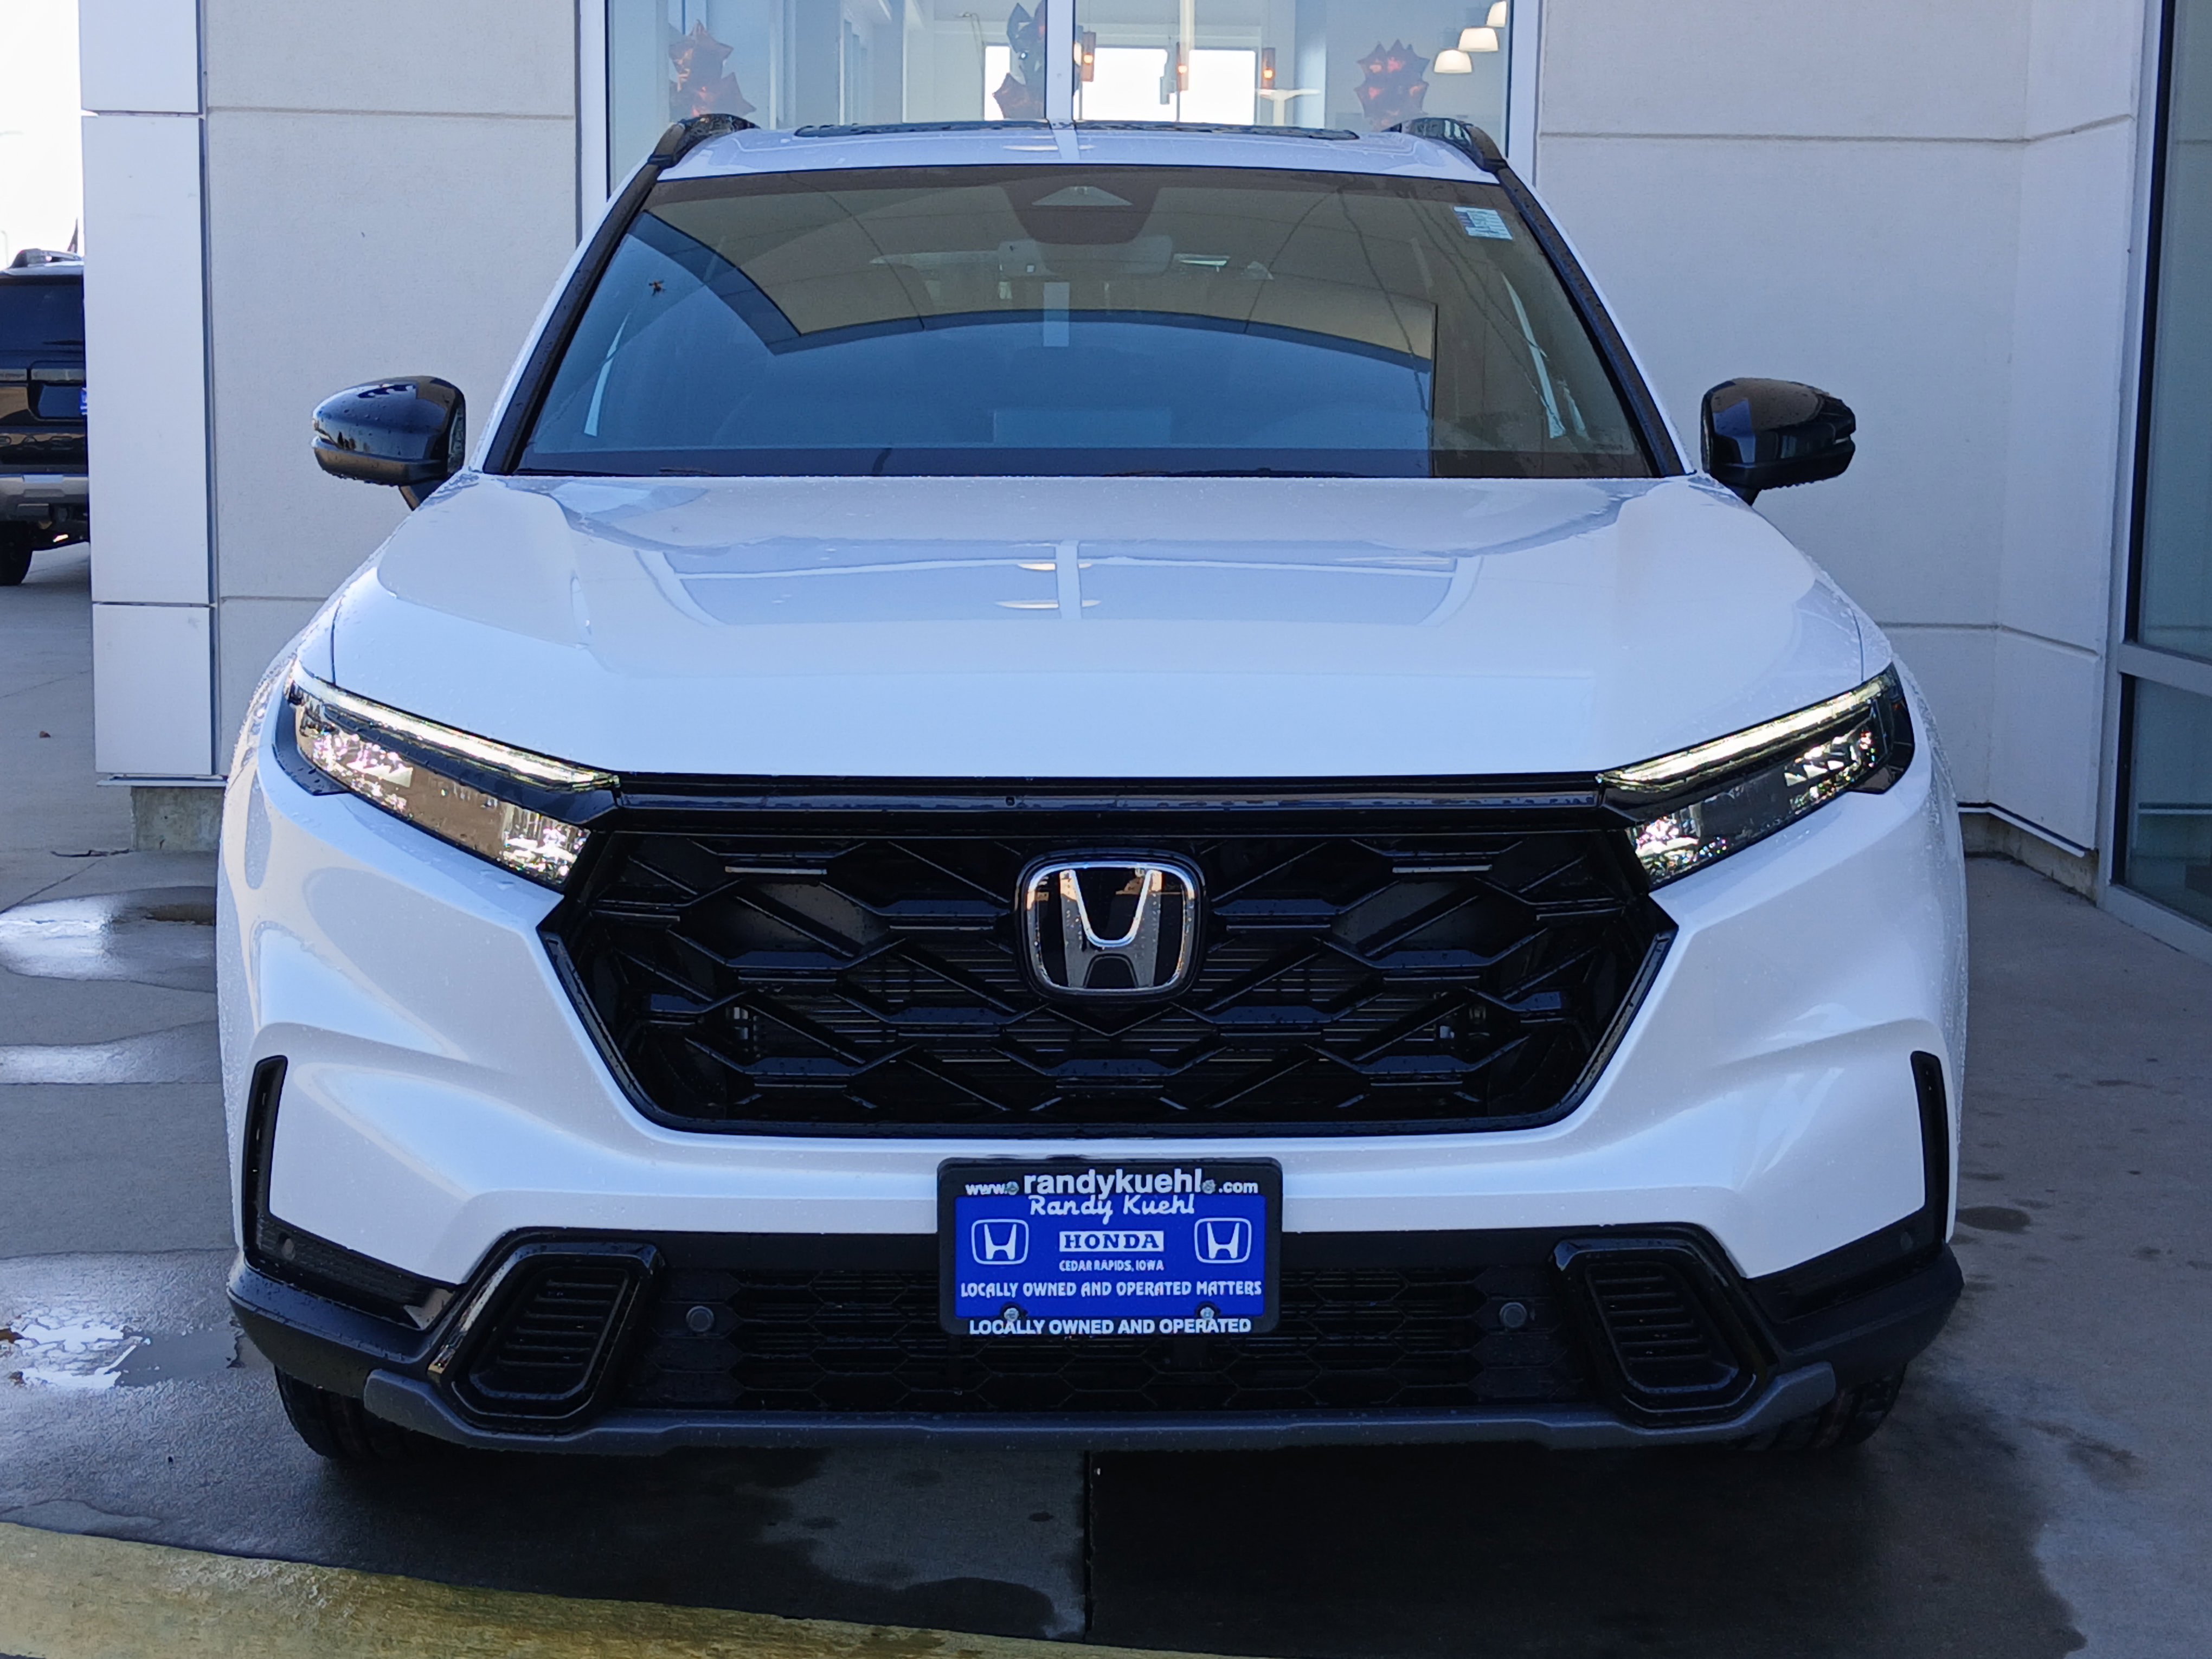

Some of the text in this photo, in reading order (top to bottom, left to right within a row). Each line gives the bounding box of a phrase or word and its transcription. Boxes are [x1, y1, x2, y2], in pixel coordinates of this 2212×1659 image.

[1024, 1168, 1202, 1200] randykuehl
[1219, 1181, 1258, 1193] .com
[1028, 1193, 1194, 1225] Randy Kuehl
[1064, 1233, 1159, 1249] HONDA
[1059, 1259, 1165, 1272] CEDAR RAPIDS, IOWA
[961, 1281, 1262, 1298] LOCALLY OWNED AND OPERATED MATTERS
[969, 1318, 1251, 1335] LOCALLY OWNED AND OPERATED
